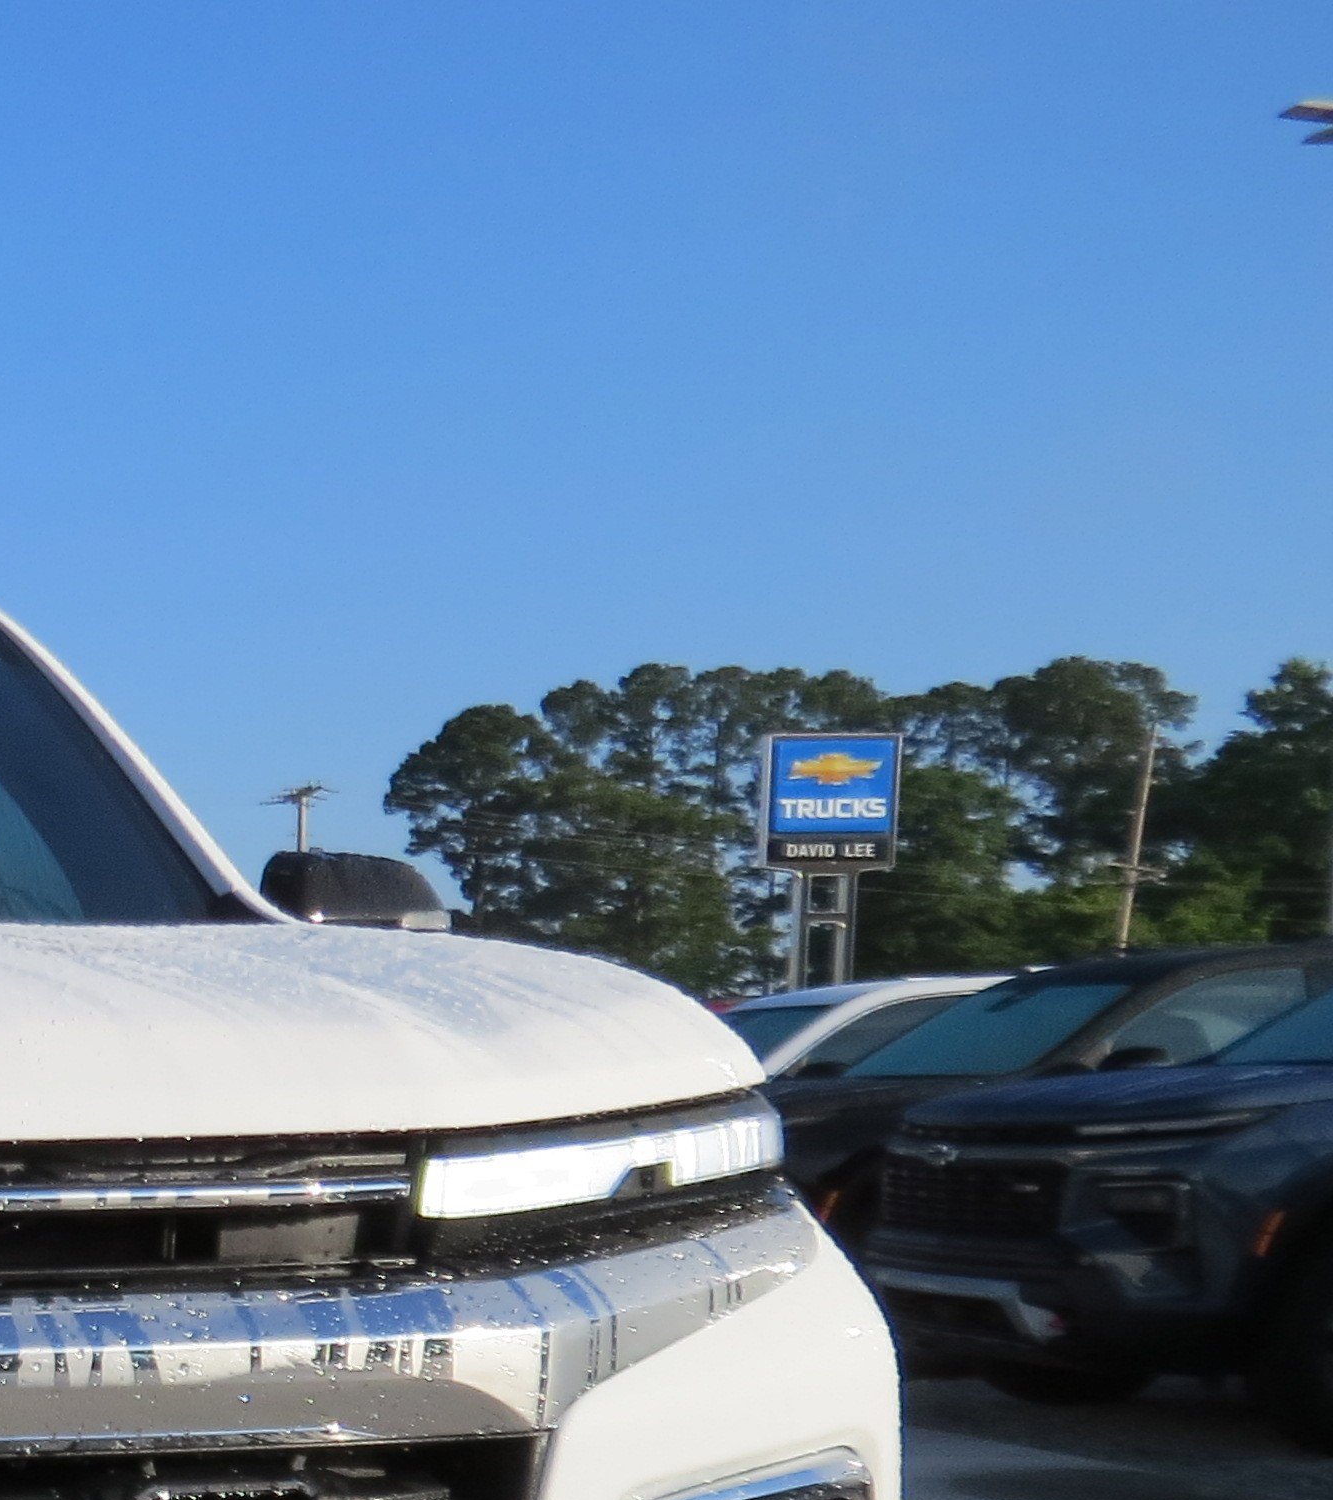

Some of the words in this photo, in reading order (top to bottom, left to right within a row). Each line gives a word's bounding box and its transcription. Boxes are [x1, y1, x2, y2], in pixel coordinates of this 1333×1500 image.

[780, 798, 886, 819] TRUCKS
[786, 843, 835, 858] DAVID
[844, 843, 876, 858] LEE
